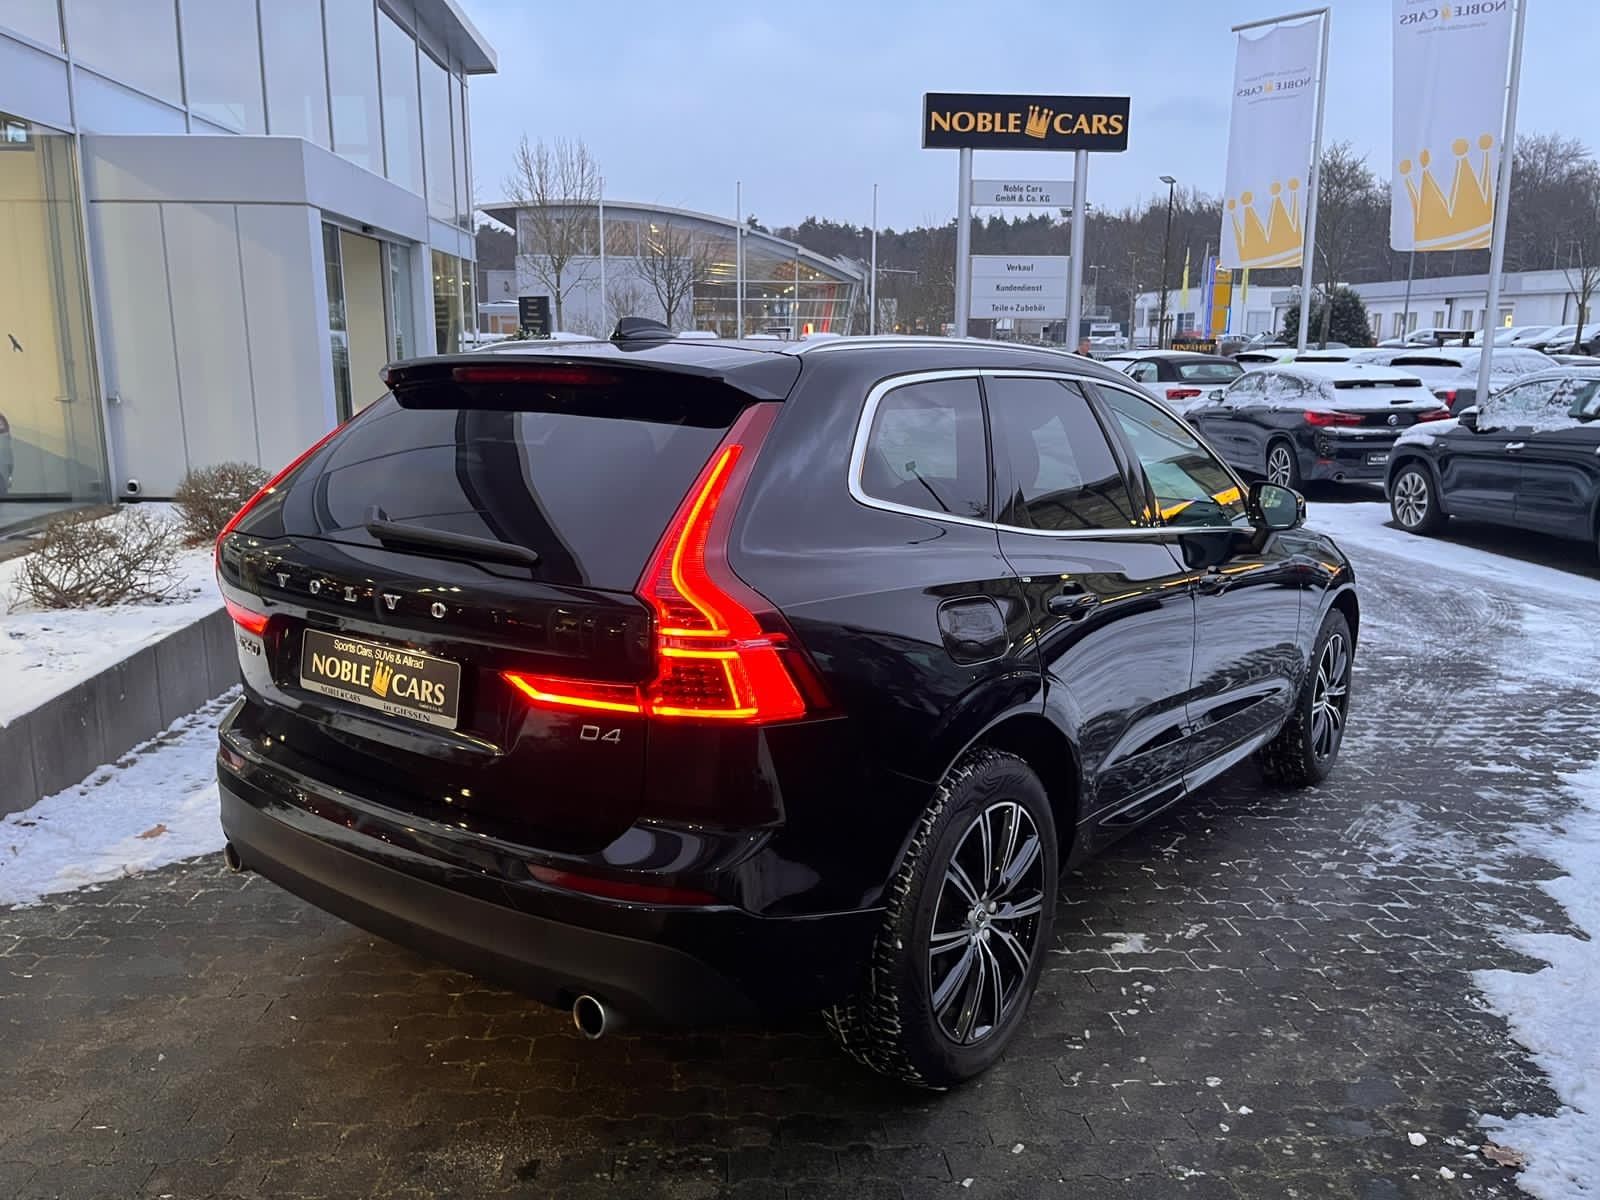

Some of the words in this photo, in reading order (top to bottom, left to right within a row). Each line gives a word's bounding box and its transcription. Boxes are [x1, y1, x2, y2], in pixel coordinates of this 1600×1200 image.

[931, 111, 1022, 134] NOBLE
[1053, 113, 1124, 136] CARS
[1003, 184, 1024, 193] Noble
[1026, 184, 1043, 193] Cars
[995, 194, 1016, 203] GmbH
[1018, 194, 1024, 203] &
[1039, 195, 1051, 204] KG
[1006, 263, 1034, 273] Verkauf
[995, 284, 1042, 293] Kundendienst
[276, 572, 447, 619] VOLVO
[334, 639, 356, 654] Sports
[374, 648, 396, 664] SUVs
[395, 654, 403, 666] &
[402, 656, 425, 670] Allrad
[312, 652, 371, 688] NOBLE
[391, 673, 445, 707] CARS
[383, 702, 391, 711] in
[392, 706, 432, 722] GIESSEN
[579, 724, 622, 745] D4
